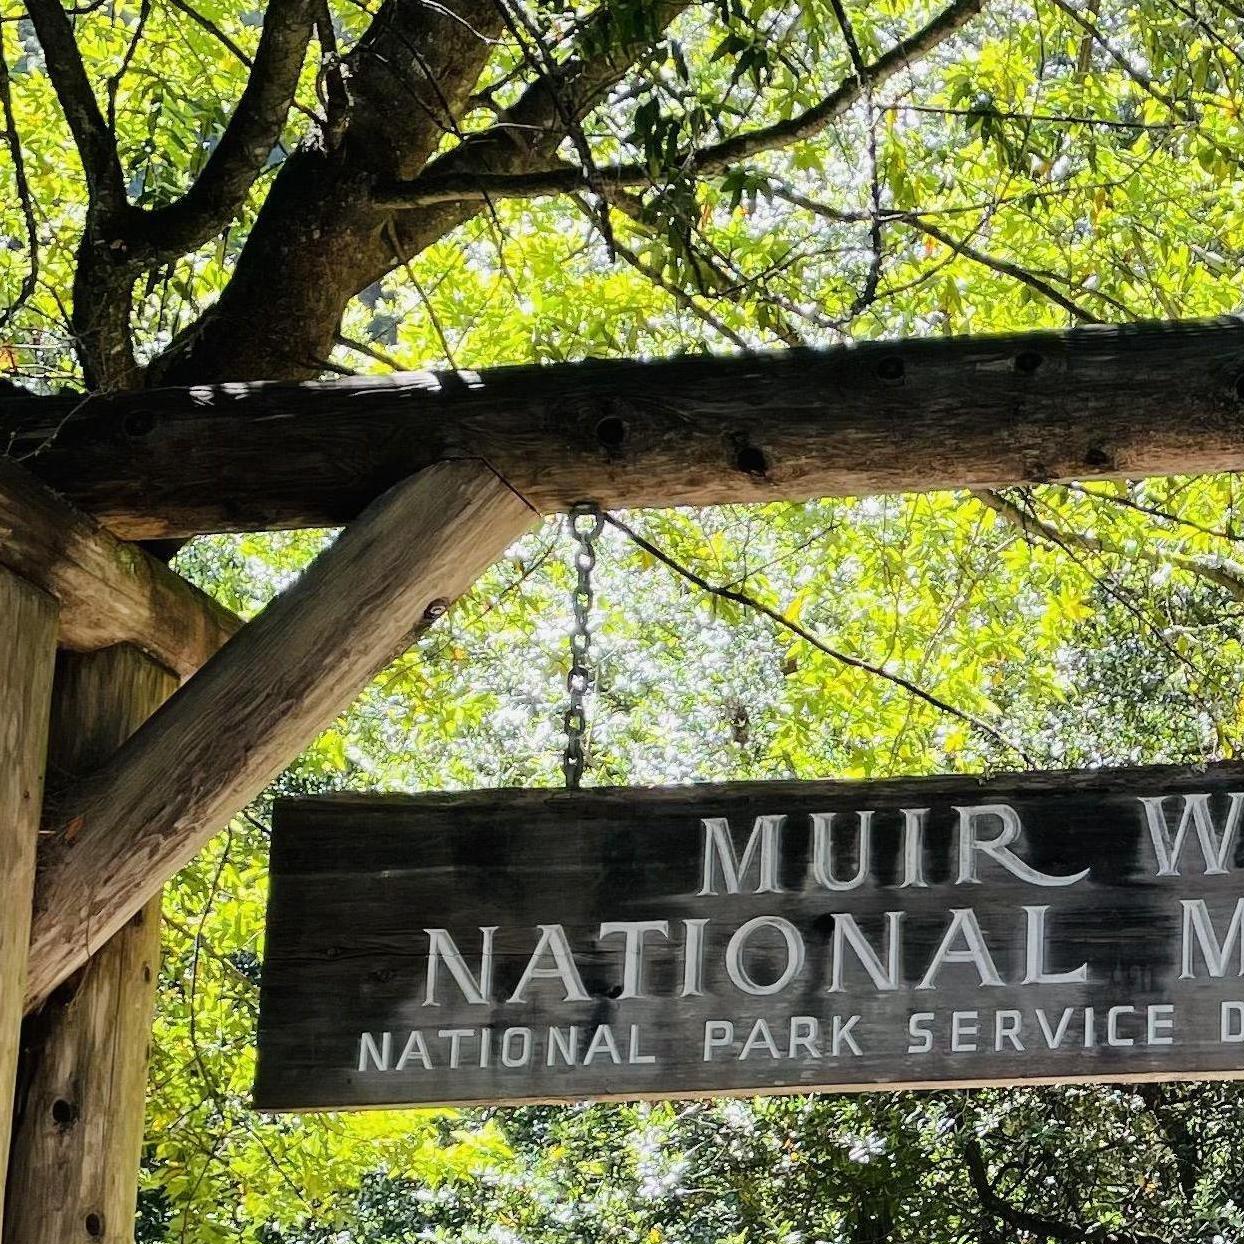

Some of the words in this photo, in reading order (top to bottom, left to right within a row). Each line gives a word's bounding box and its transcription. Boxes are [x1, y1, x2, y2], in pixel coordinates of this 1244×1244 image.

[697, 805, 1089, 897] MUIR
[421, 905, 1088, 1007] NATIONAL
[357, 1023, 656, 1072] NATIONAL
[703, 1014, 864, 1062] PARK
[907, 1004, 1175, 1053] SERVICE
